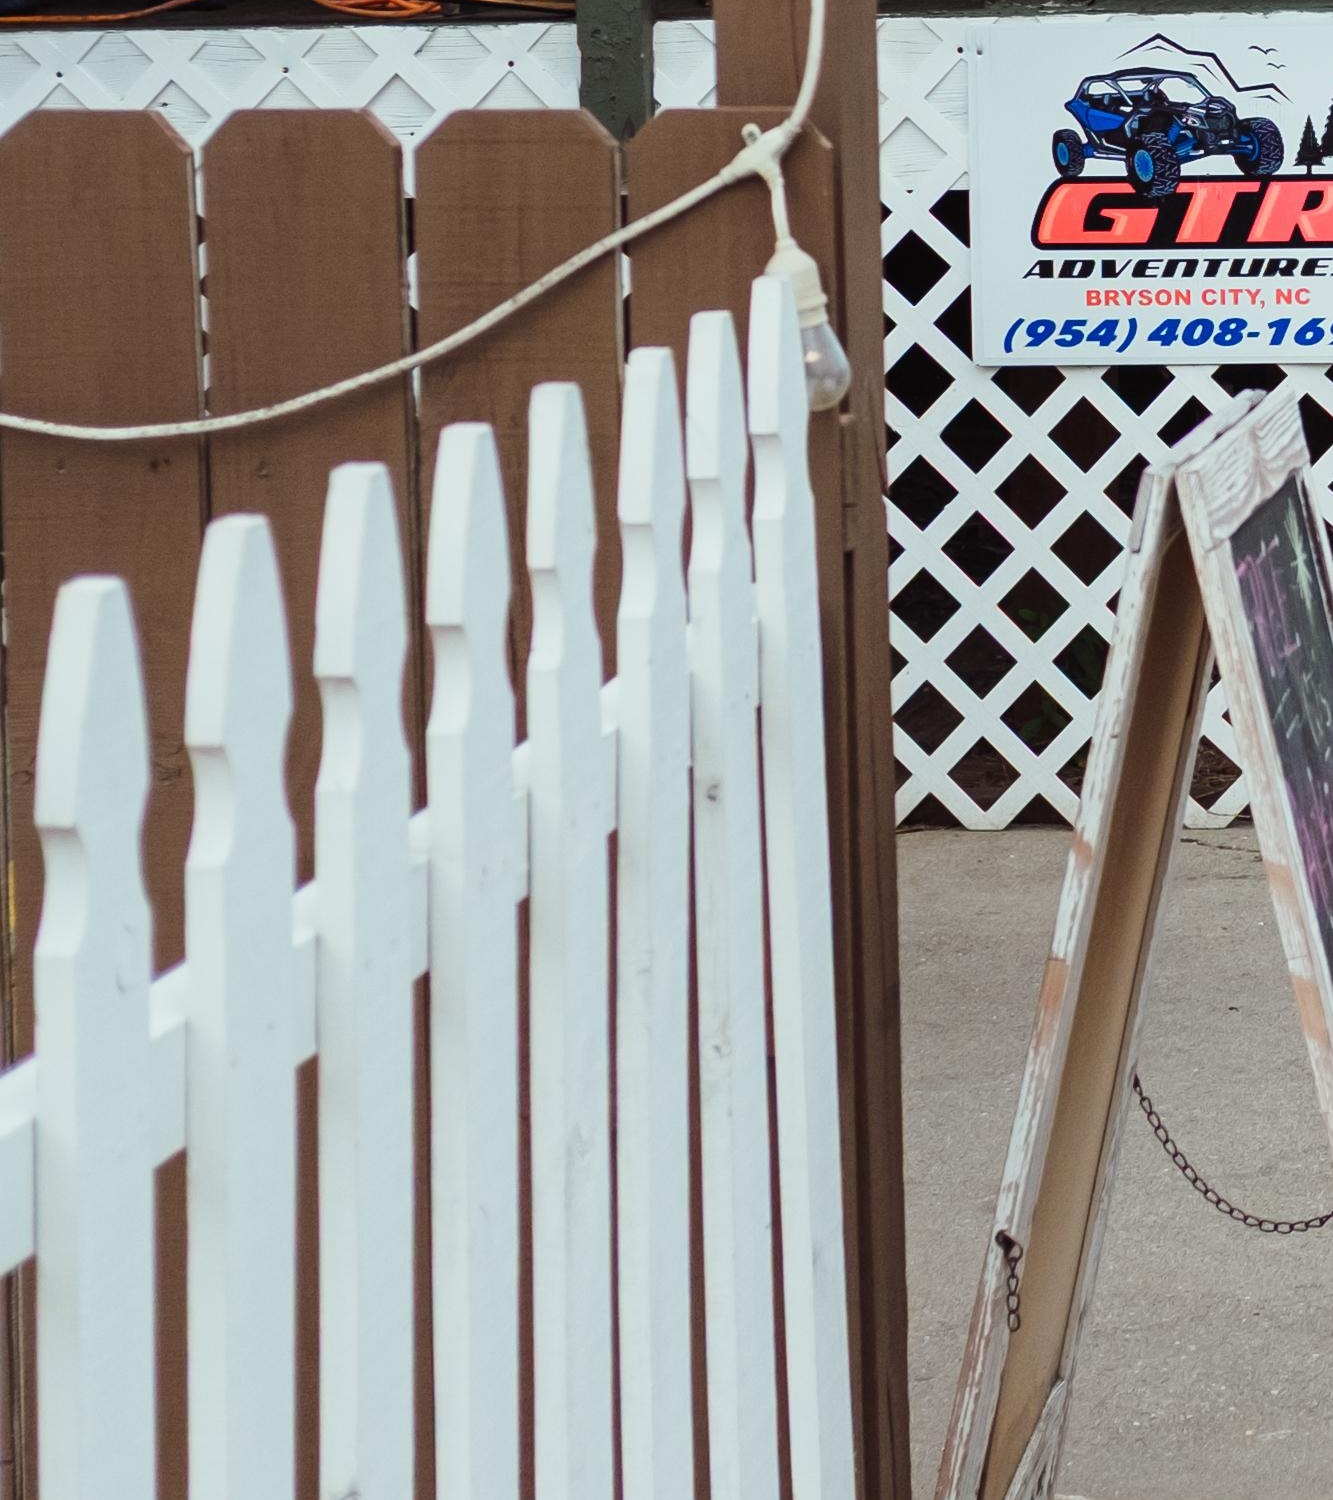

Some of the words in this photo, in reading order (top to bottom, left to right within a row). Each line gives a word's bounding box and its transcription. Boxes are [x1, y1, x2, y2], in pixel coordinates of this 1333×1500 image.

[1085, 288, 1191, 307] BRYSON
[1201, 288, 1266, 309] CITY,
[1275, 287, 1311, 306] NC
[1002, 317, 1139, 354] (954)
